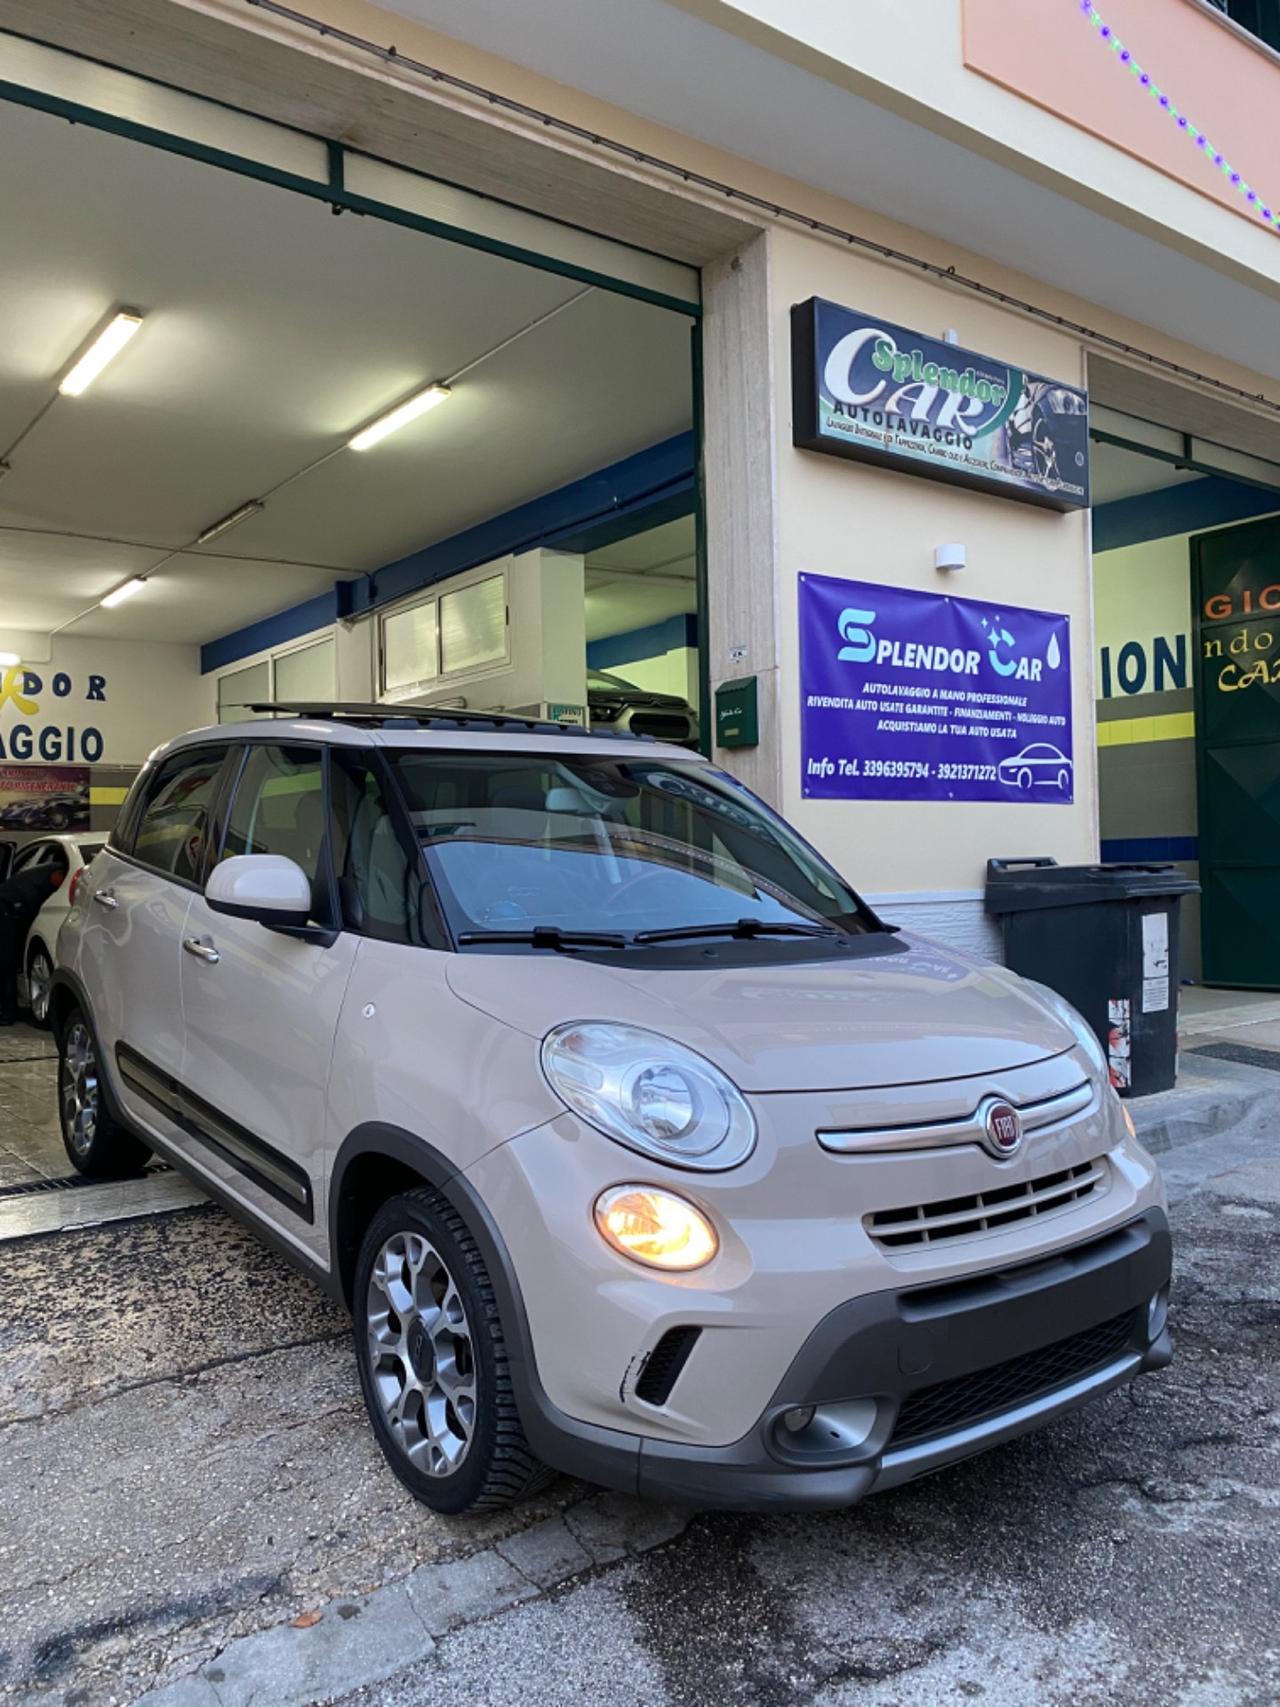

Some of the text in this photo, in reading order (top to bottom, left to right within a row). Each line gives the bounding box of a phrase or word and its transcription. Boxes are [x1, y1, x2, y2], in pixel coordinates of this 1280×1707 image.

[825, 328, 976, 436] CAR
[872, 338, 1005, 406] Splendor
[833, 401, 973, 449] AUTOLAVAGGIO
[838, 607, 1042, 682] SPLENDOR CAR
[1101, 634, 1187, 698] ION
[0, 672, 106, 701] DOR
[862, 682, 1027, 707] AUTOLAVAGGIO A MANO PROFESSIONALE
[807, 695, 854, 710] RIVENDITA
[855, 699, 878, 711] AUTO
[880, 701, 904, 714] USATE
[905, 703, 948, 717] GARANTITE
[954, 707, 1012, 721] FINANZIAMENTI
[1049, 716, 1066, 726] AUTO
[877, 719, 1017, 738] ACQUISTIAMO LA TUA AUTO USATA
[807, 757, 835, 778] Info
[838, 758, 860, 776] Tel.
[863, 760, 929, 778] 3396395794
[937, 763, 997, 780] 3921371272
[994, 1115, 1015, 1139] FIAT
